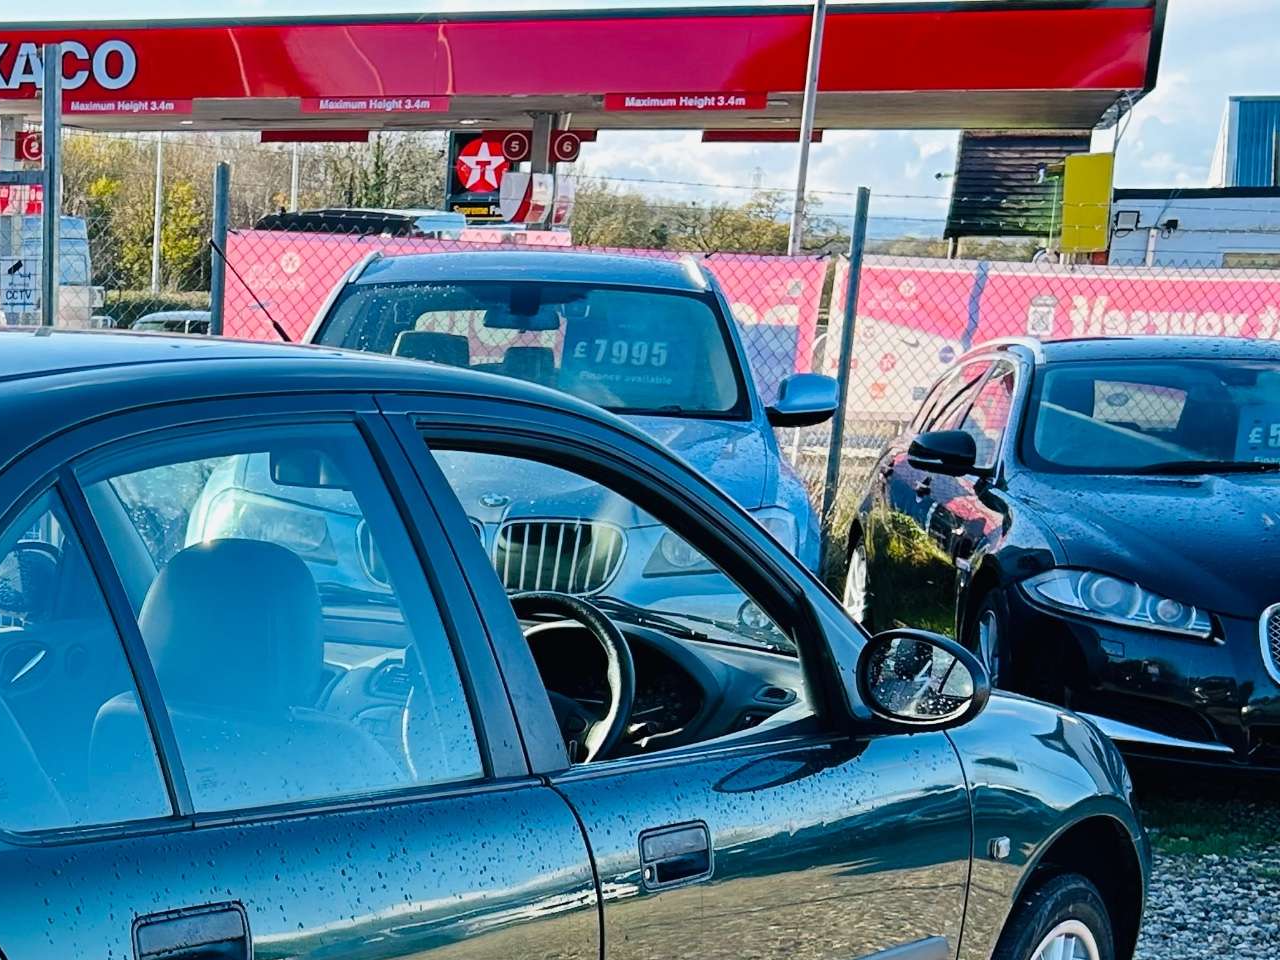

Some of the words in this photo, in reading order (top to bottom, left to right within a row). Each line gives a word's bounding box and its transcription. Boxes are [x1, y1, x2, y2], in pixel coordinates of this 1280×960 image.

[71, 101, 115, 111] Maximum
[117, 101, 148, 113] Height
[149, 101, 175, 111] 3.4m
[319, 99, 367, 109] Maximum
[369, 99, 402, 111] Height
[404, 99, 430, 109] 3.4m
[625, 96, 677, 107] Maximum
[679, 96, 715, 109] Height
[717, 95, 746, 106] 3.4m
[30, 141, 39, 153] 2
[510, 140, 520, 152] 5
[562, 140, 572, 152] 6
[6, 290, 32, 300] CCTV
[580, 370, 621, 381] Finance
[624, 375, 673, 385] available
